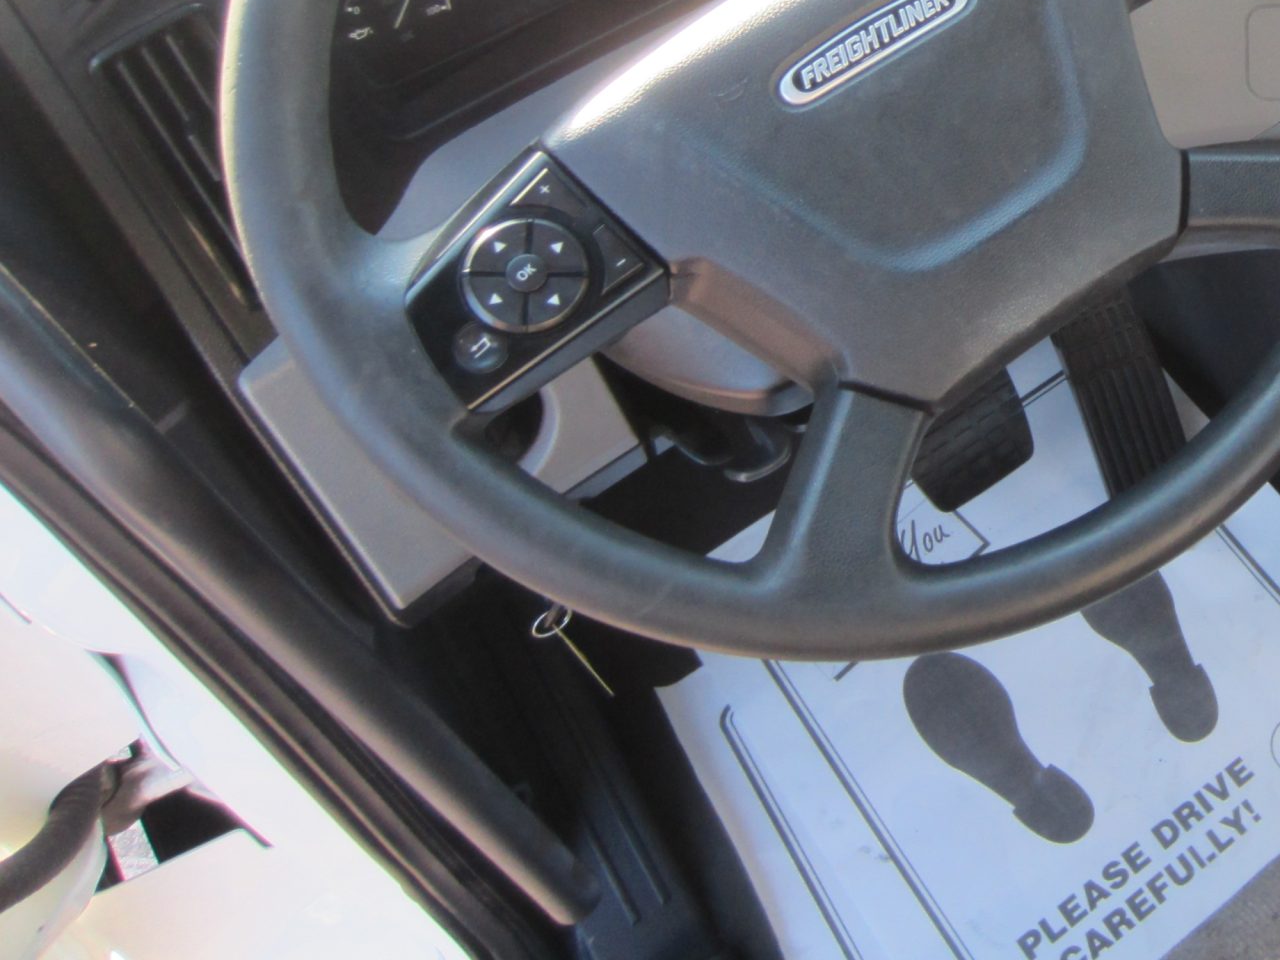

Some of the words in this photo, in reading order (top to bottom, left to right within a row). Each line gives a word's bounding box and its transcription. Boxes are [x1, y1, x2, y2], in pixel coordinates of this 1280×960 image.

[515, 263, 538, 282] OK
[1016, 841, 1152, 960] PLEASE
[1151, 756, 1255, 850] DRIVE
[1059, 799, 1262, 960] CAREFULLY!
